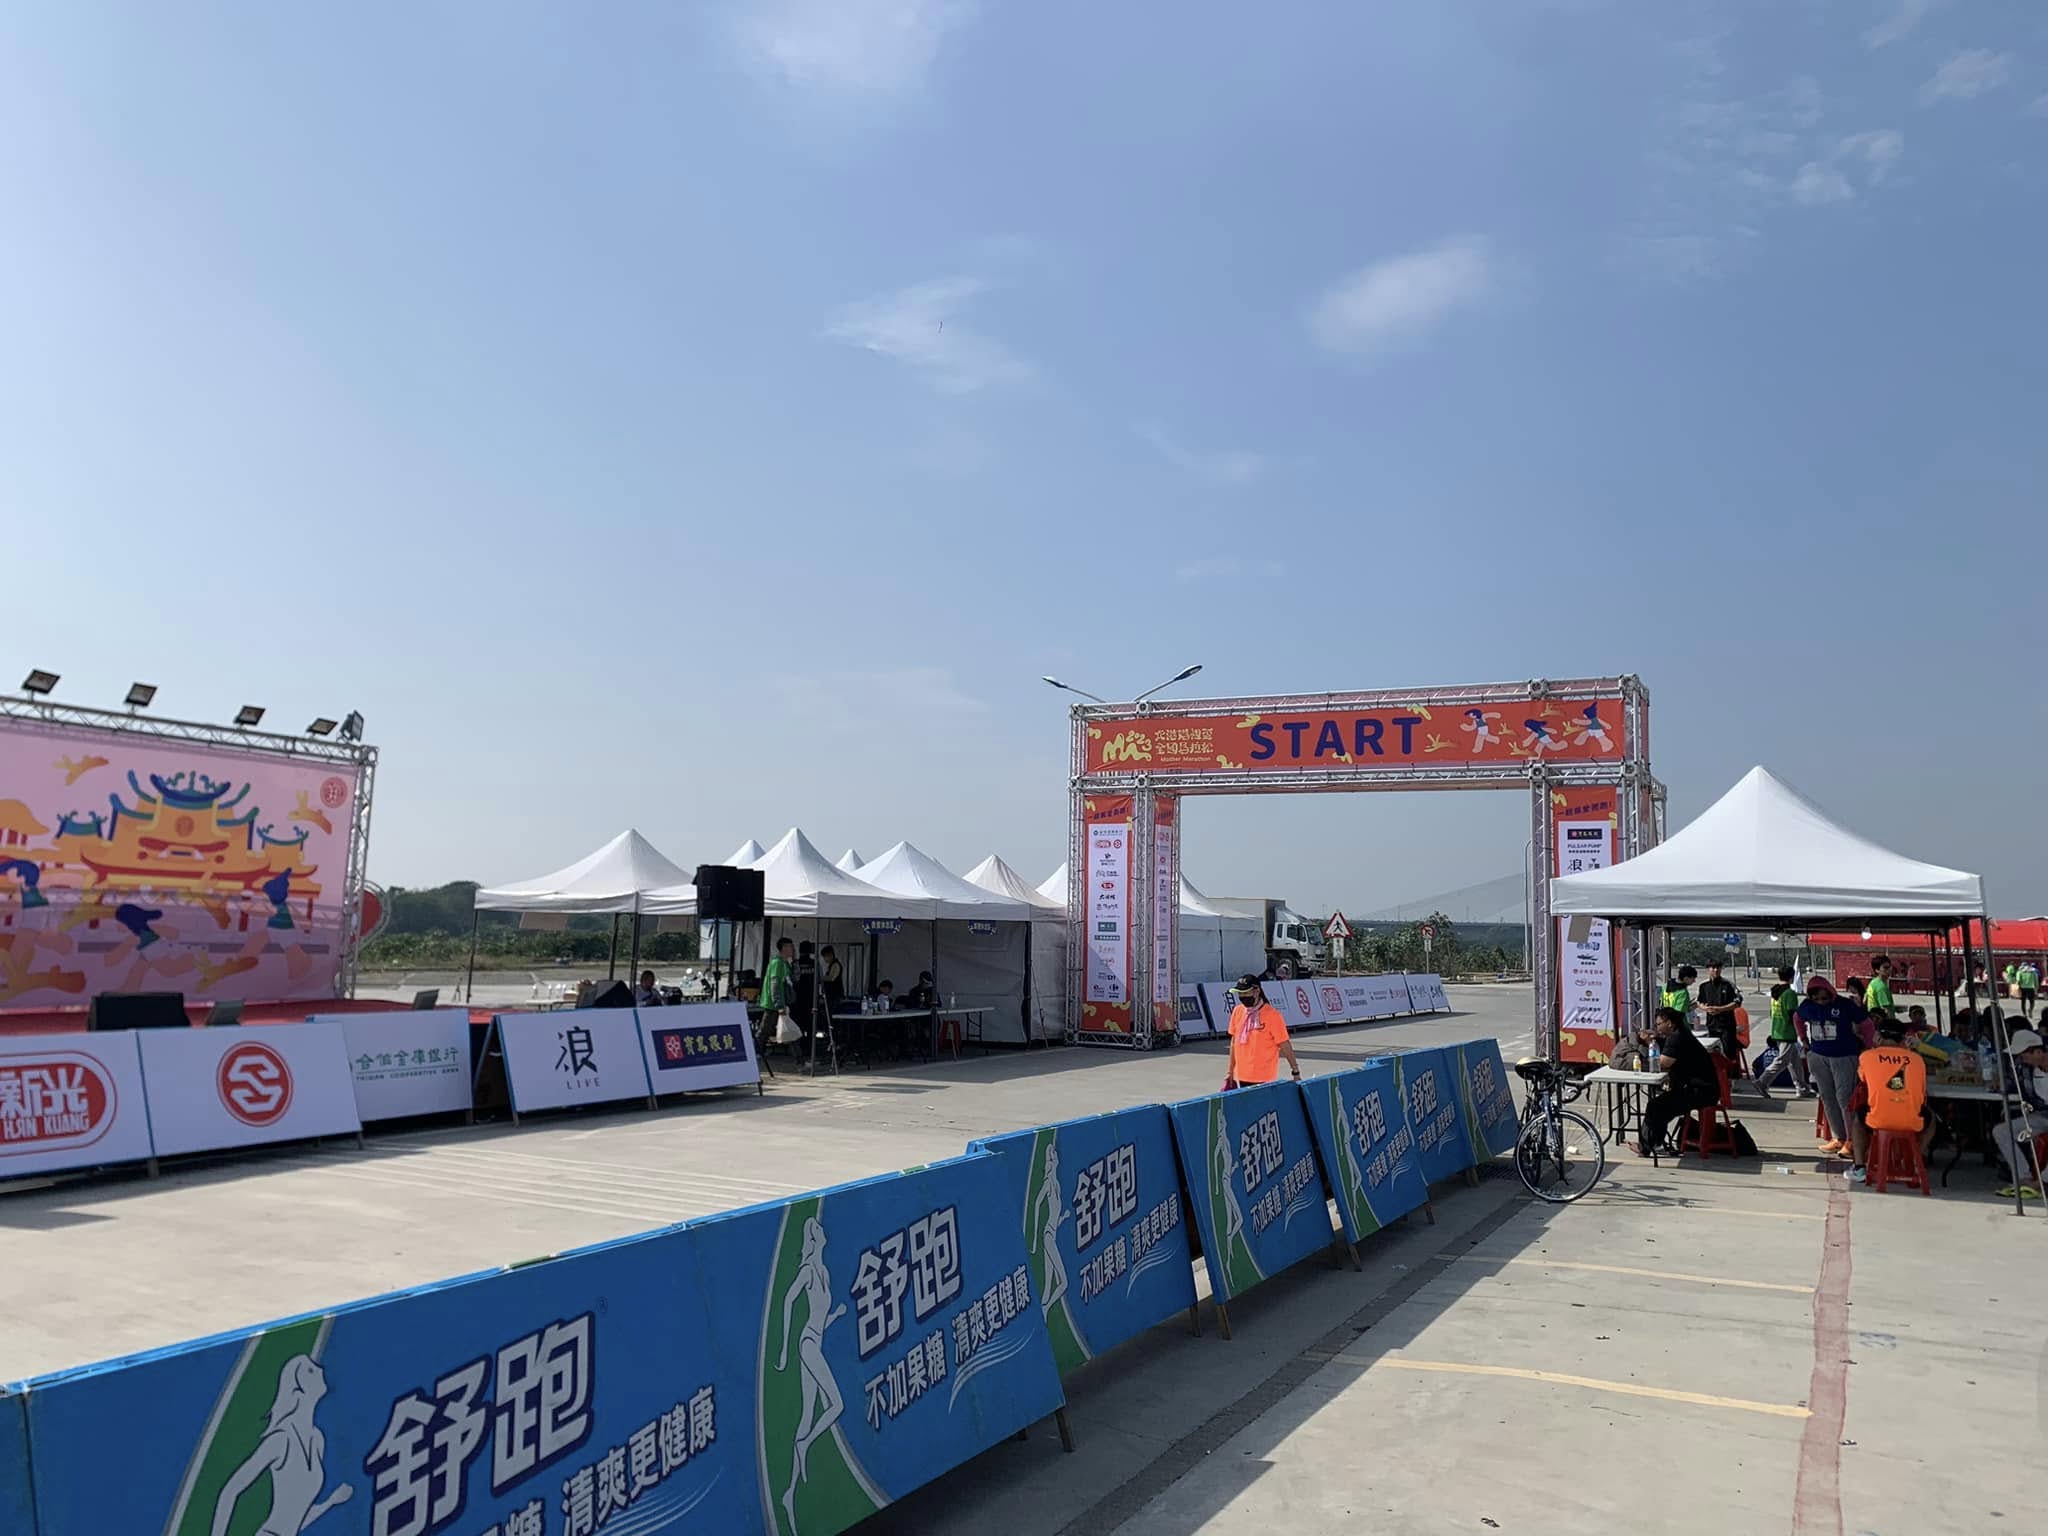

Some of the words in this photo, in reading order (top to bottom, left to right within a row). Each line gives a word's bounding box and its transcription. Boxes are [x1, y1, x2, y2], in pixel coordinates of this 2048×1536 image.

[1250, 716, 1422, 760] START
[555, 1026, 598, 1076] 浪
[567, 1077, 600, 1090] LIVE
[1878, 1054, 1911, 1065] MH3
[44, 1113, 90, 1135] KUANG
[1353, 1089, 1387, 1157] 舒跑
[1411, 1070, 1438, 1125] 舒跑
[1239, 1110, 1284, 1194] 舒跑
[1072, 1143, 1138, 1250] 舒跑
[850, 1206, 962, 1356] 舒跑
[1079, 1235, 1127, 1303] 不加果糖
[1130, 1192, 1179, 1261] 清爽更健康
[865, 1329, 946, 1429] 不加果糖
[951, 1264, 1031, 1364] 清爽更健康
[366, 1313, 593, 1536] 舒跑
[561, 1384, 716, 1536] 清爽更健康
